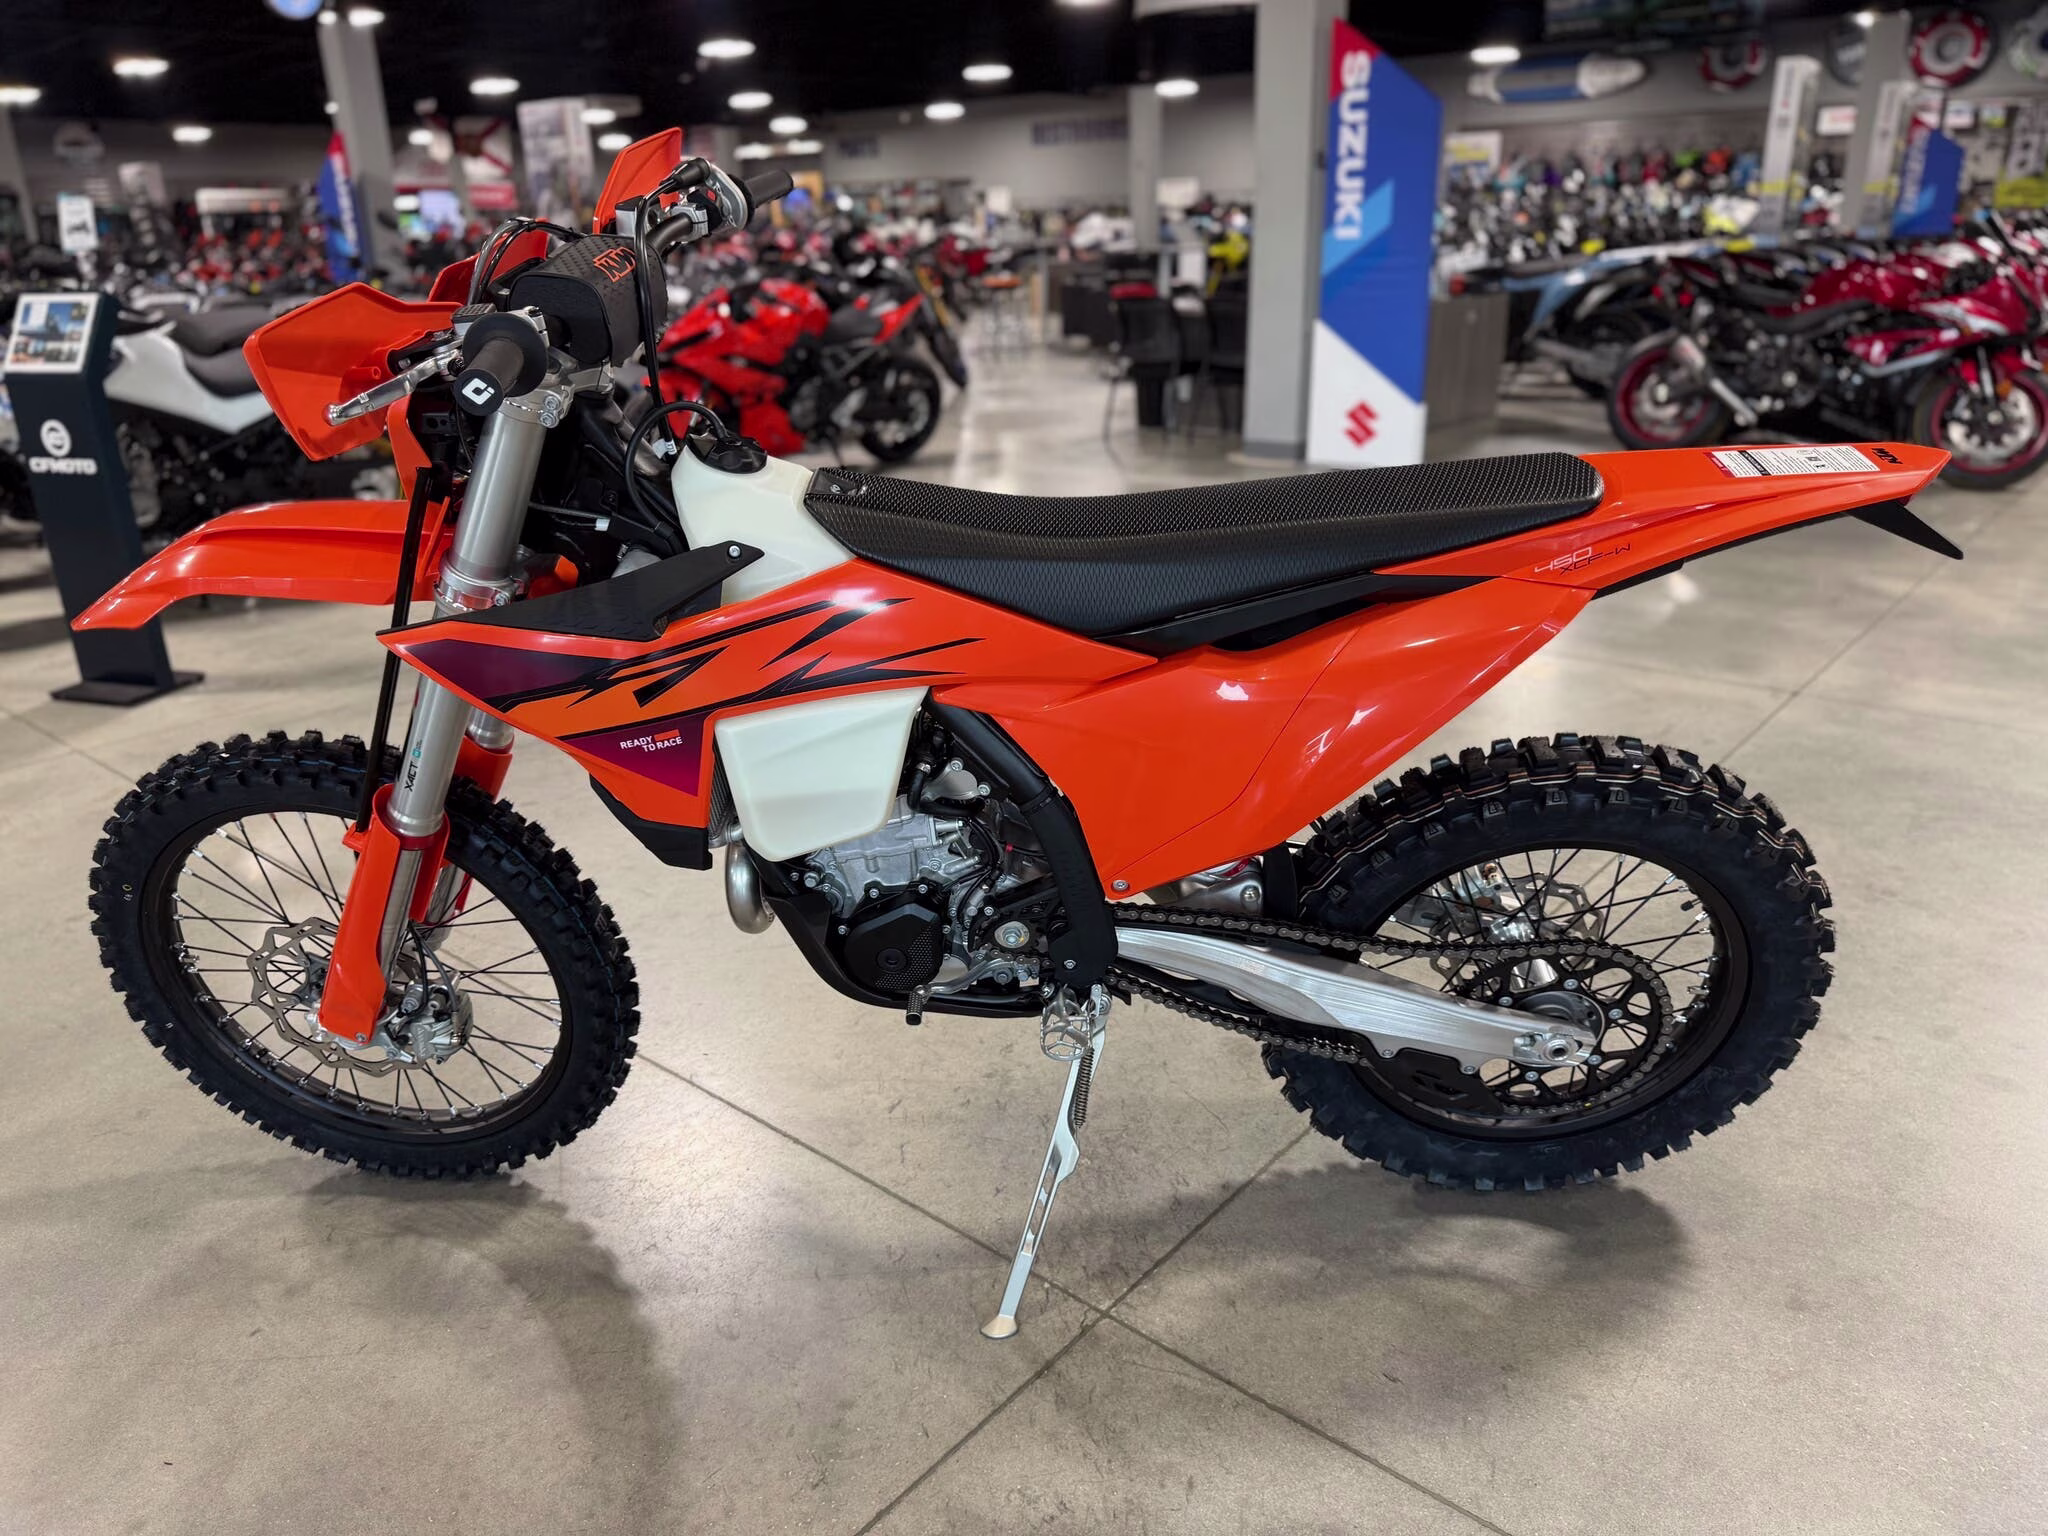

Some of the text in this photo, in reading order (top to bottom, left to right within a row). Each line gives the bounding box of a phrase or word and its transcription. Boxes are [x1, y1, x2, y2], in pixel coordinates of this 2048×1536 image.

[1333, 50, 1371, 240] SUZUKI
[1534, 546, 1592, 573] 450
[1559, 543, 1631, 576] XCF-W
[620, 735, 653, 750] READY
[642, 736, 683, 752] TO RACE
[404, 760, 419, 792] XACT
